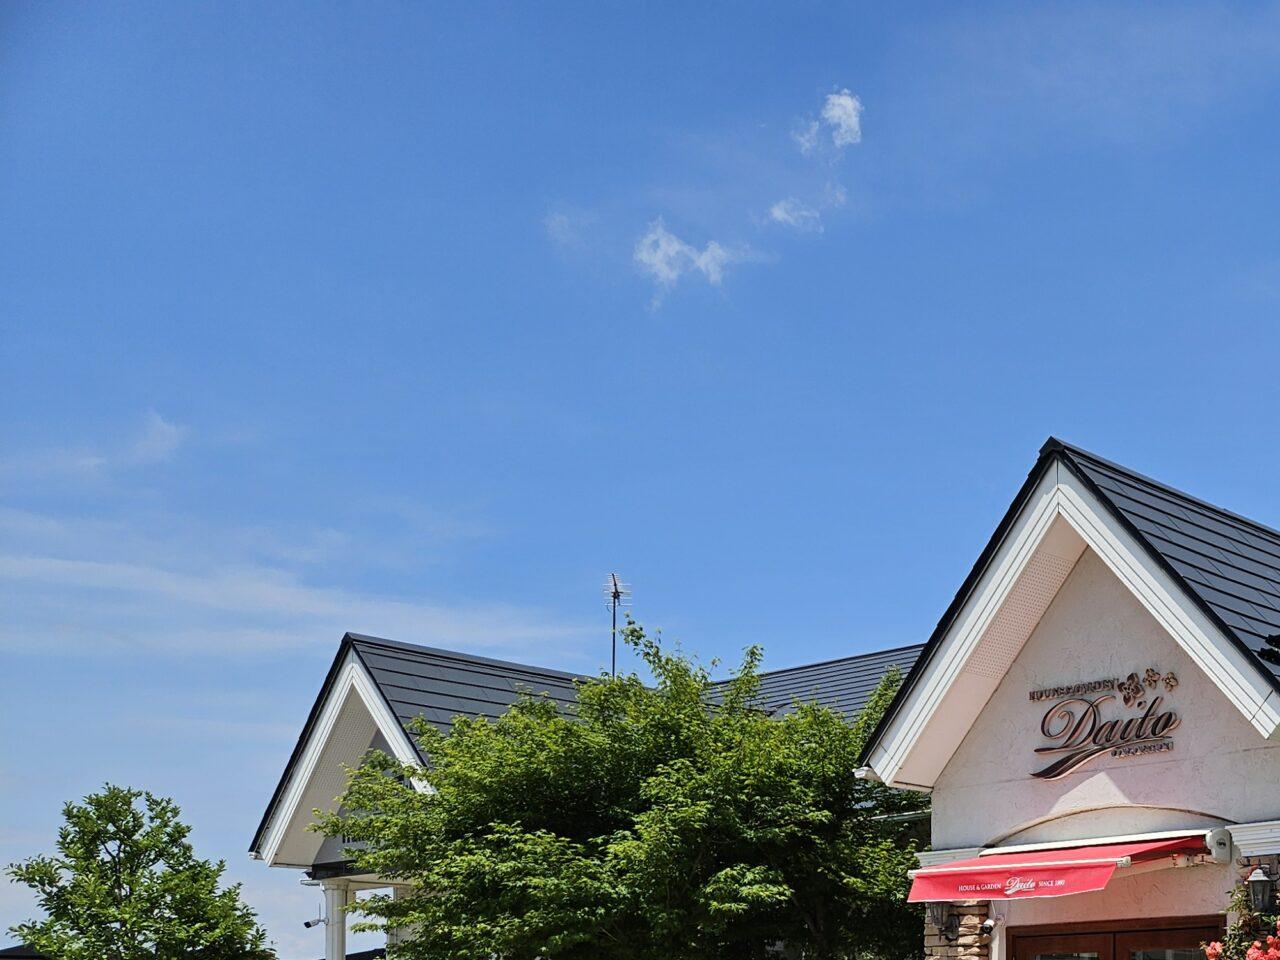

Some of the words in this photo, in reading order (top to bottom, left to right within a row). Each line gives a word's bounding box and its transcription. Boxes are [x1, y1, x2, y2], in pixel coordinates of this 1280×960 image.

[1034, 693, 1181, 755] Daito
[959, 884, 976, 892] HOUSE
[1004, 877, 1035, 893] Daito
